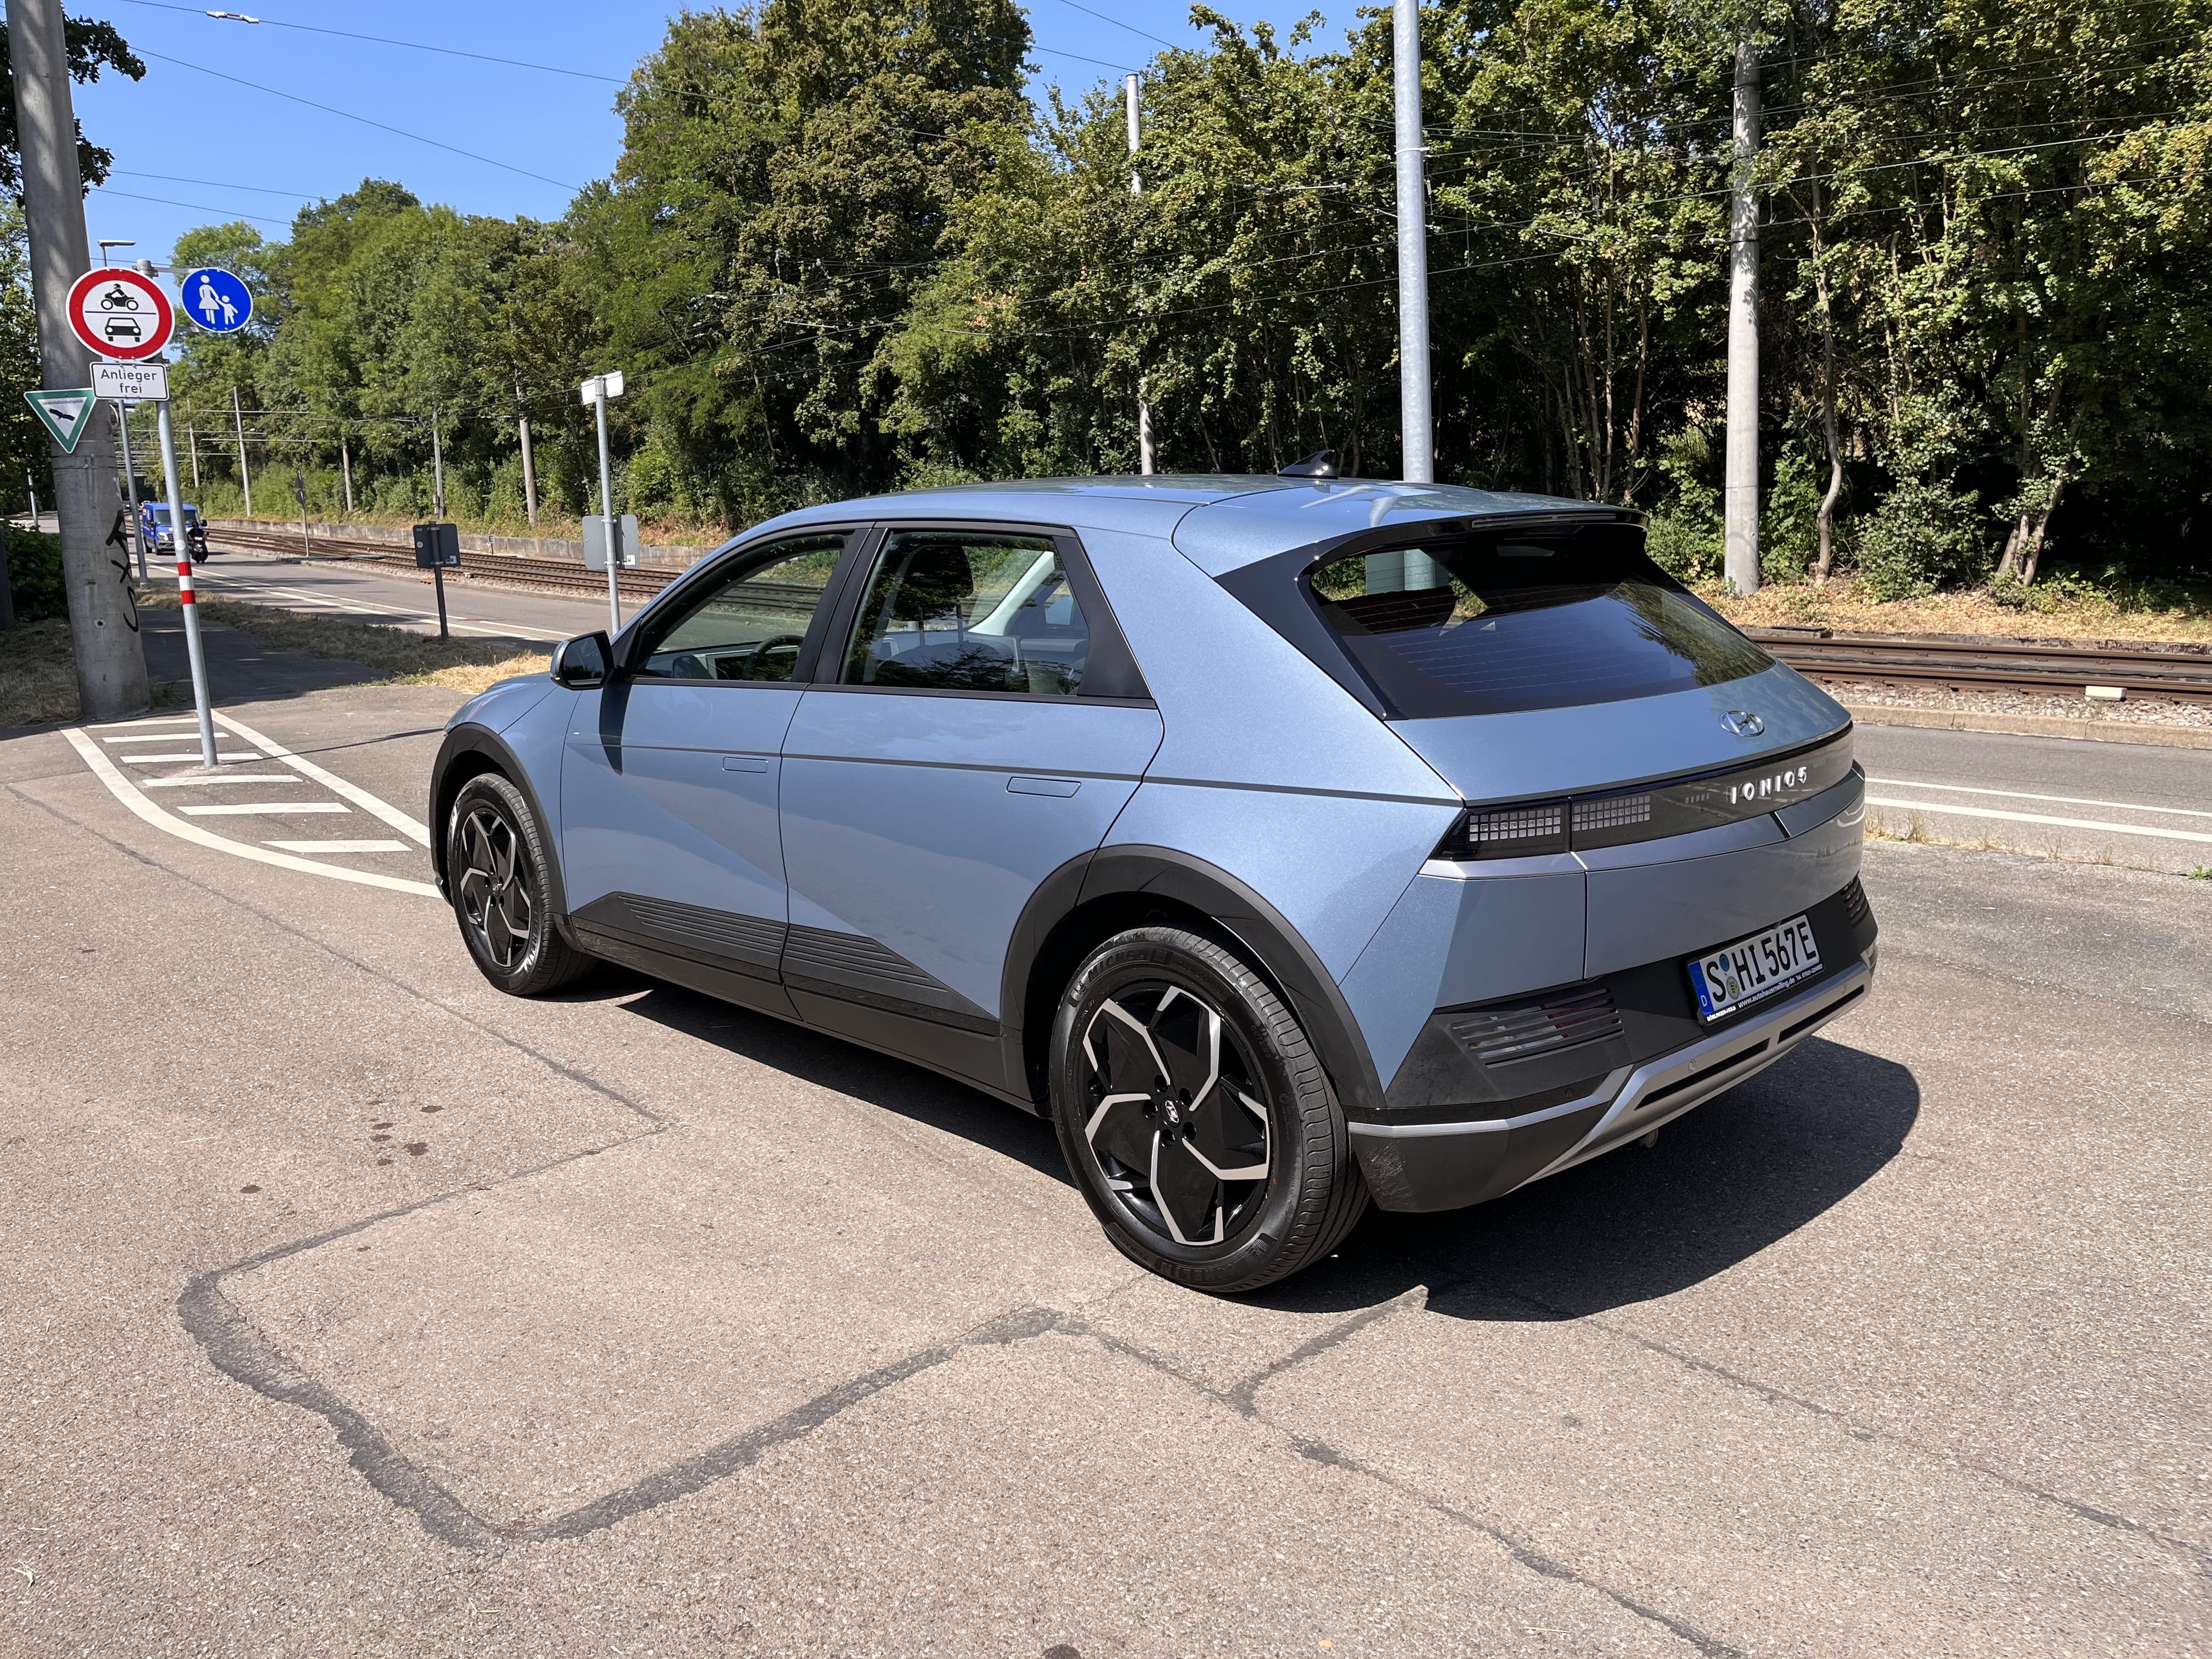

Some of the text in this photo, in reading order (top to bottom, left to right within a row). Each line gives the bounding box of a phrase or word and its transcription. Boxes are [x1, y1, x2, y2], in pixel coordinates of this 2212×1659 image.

[100, 369, 157, 382] Anlieger
[120, 383, 143, 393] frei
[1700, 995, 1708, 1007] D
